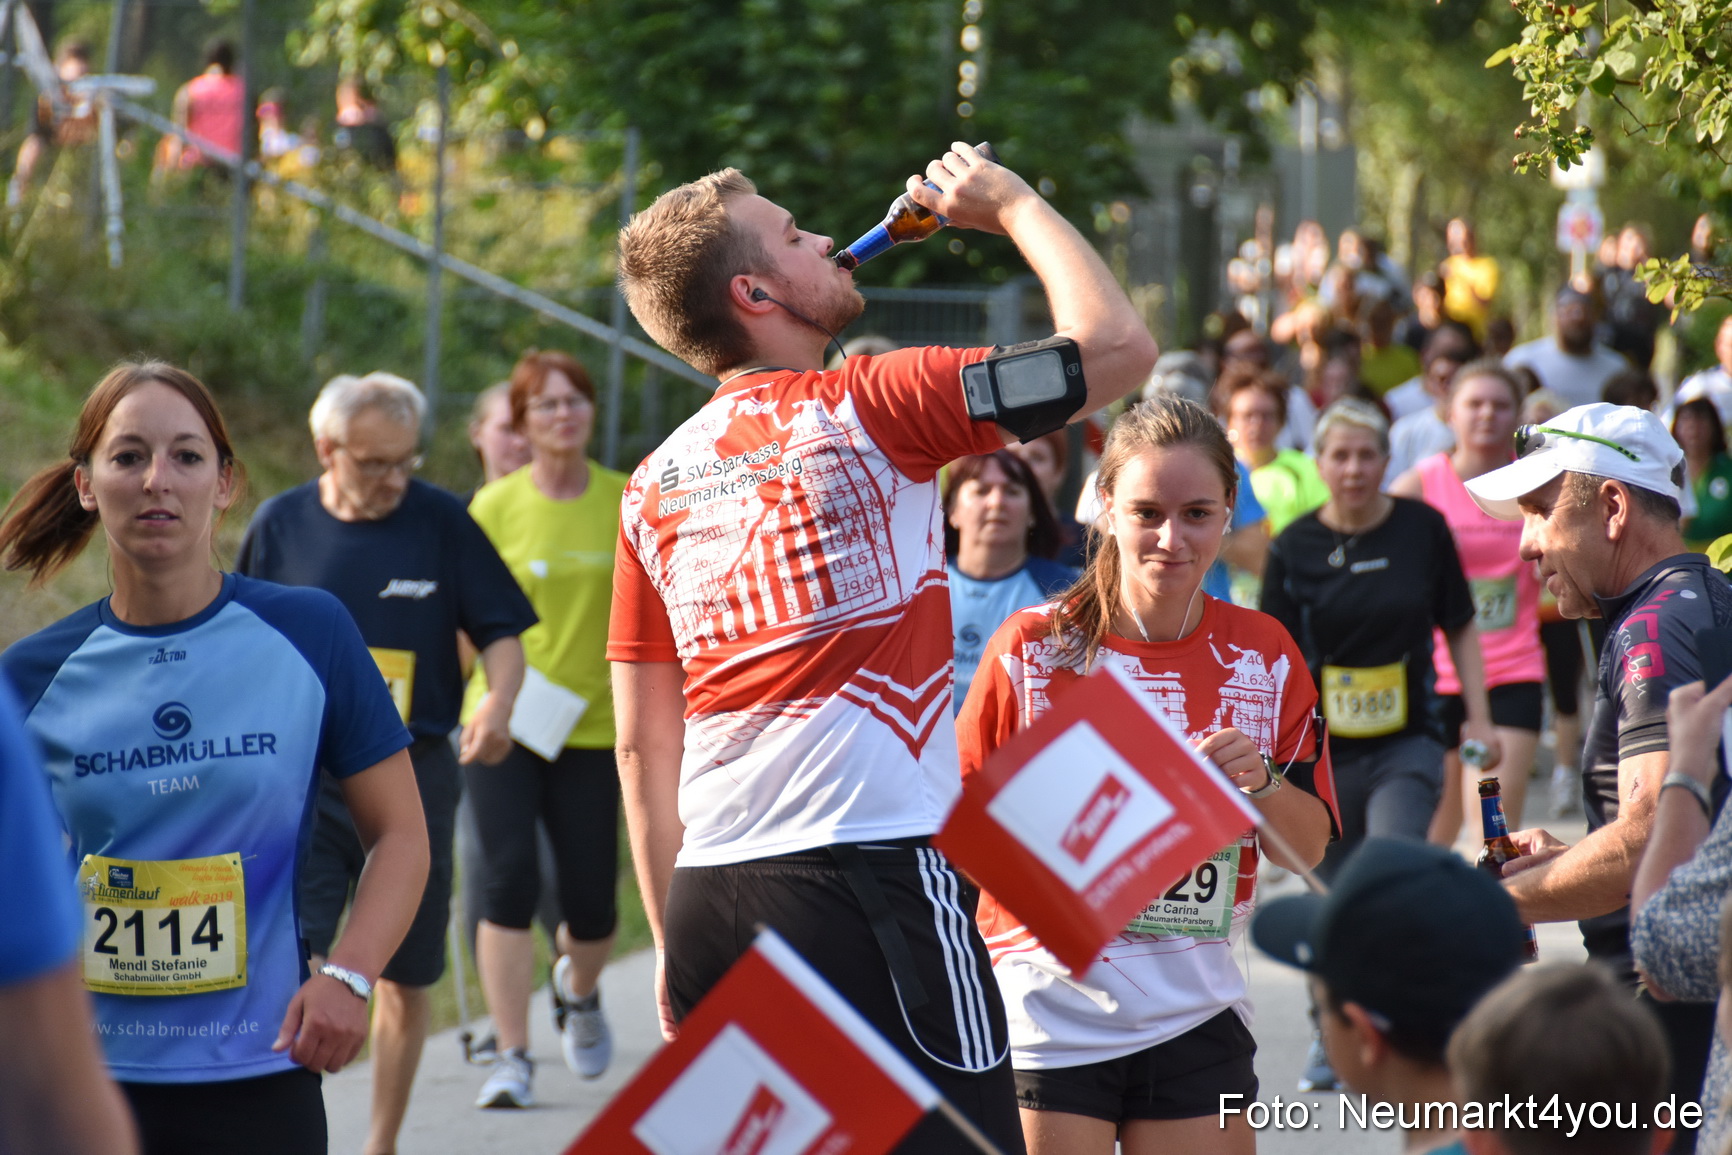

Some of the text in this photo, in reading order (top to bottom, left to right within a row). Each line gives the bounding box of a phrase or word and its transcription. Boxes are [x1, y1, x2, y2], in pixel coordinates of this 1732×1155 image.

[687, 442, 780, 483] SV Sparkasse
[659, 457, 803, 518] Neumarkt-Parsberg
[74, 732, 277, 778] SCHABMÜLLER
[147, 774, 200, 796] TEAM
[1156, 862, 1218, 904] 29
[169, 890, 233, 907] walk 2019
[1163, 903, 1199, 916] Carina
[93, 905, 224, 957] 2114
[1143, 914, 1214, 927] Neumarkt-Parsberg
[109, 957, 208, 972] Mendl Stefanie
[114, 971, 202, 983] Schabmüller GmbH
